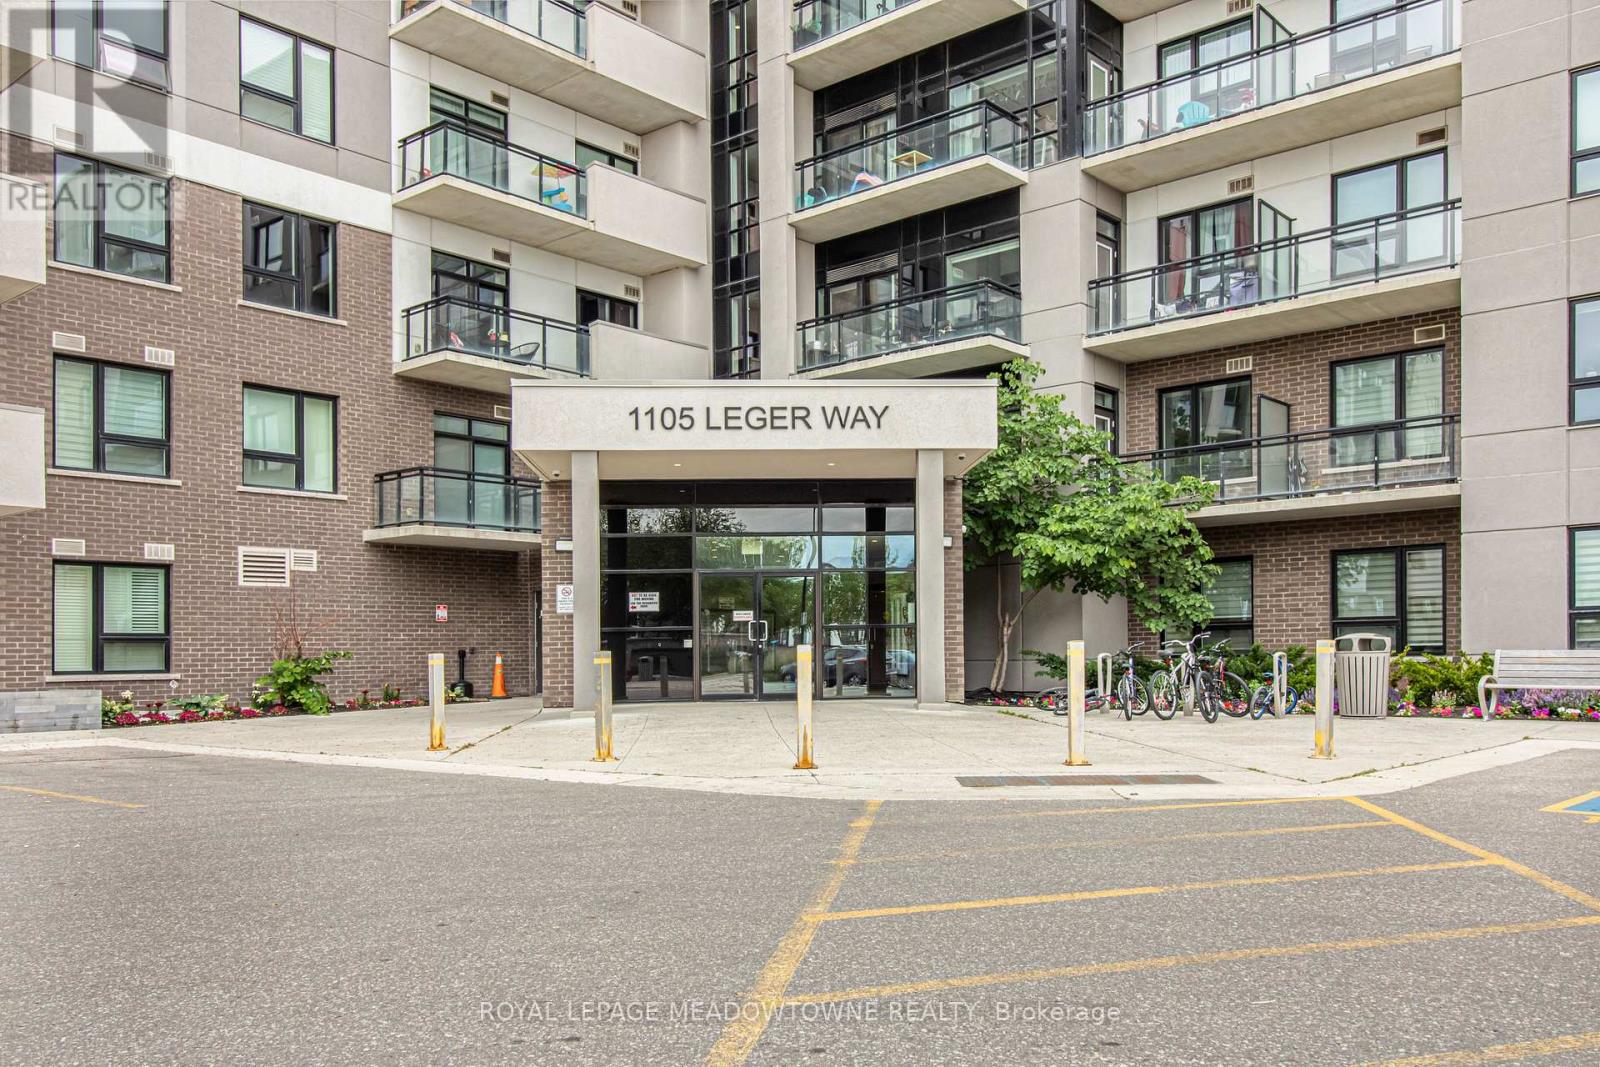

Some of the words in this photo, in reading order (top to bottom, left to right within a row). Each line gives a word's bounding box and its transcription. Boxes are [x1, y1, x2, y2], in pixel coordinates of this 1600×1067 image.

[628, 406, 695, 431] 1105
[705, 406, 812, 430] LEGER
[821, 405, 890, 429] WAY
